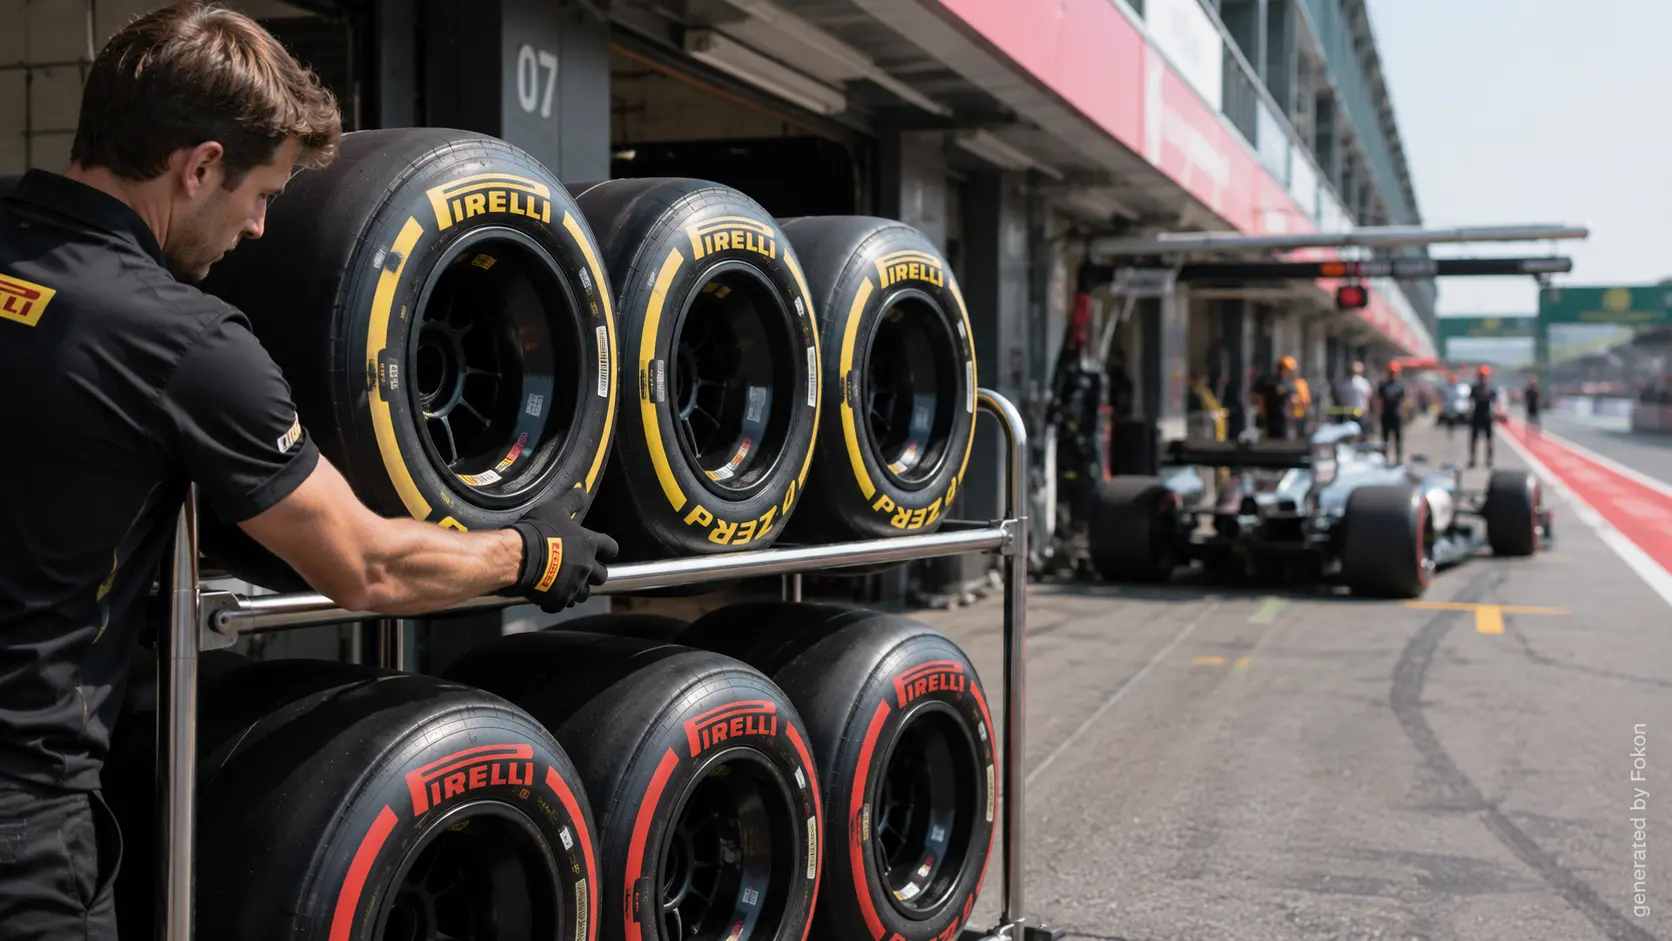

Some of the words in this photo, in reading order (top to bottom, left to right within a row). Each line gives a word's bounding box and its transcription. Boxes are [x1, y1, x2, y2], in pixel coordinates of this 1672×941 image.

[517, 44, 558, 118] 07
[426, 173, 551, 231] PIRELLI
[684, 216, 777, 260] PIRELLI
[874, 250, 945, 289] PIRELLI
[892, 660, 965, 709] PIRELLI
[683, 699, 778, 758] PIRELLI
[405, 743, 534, 816] PIRELLI
